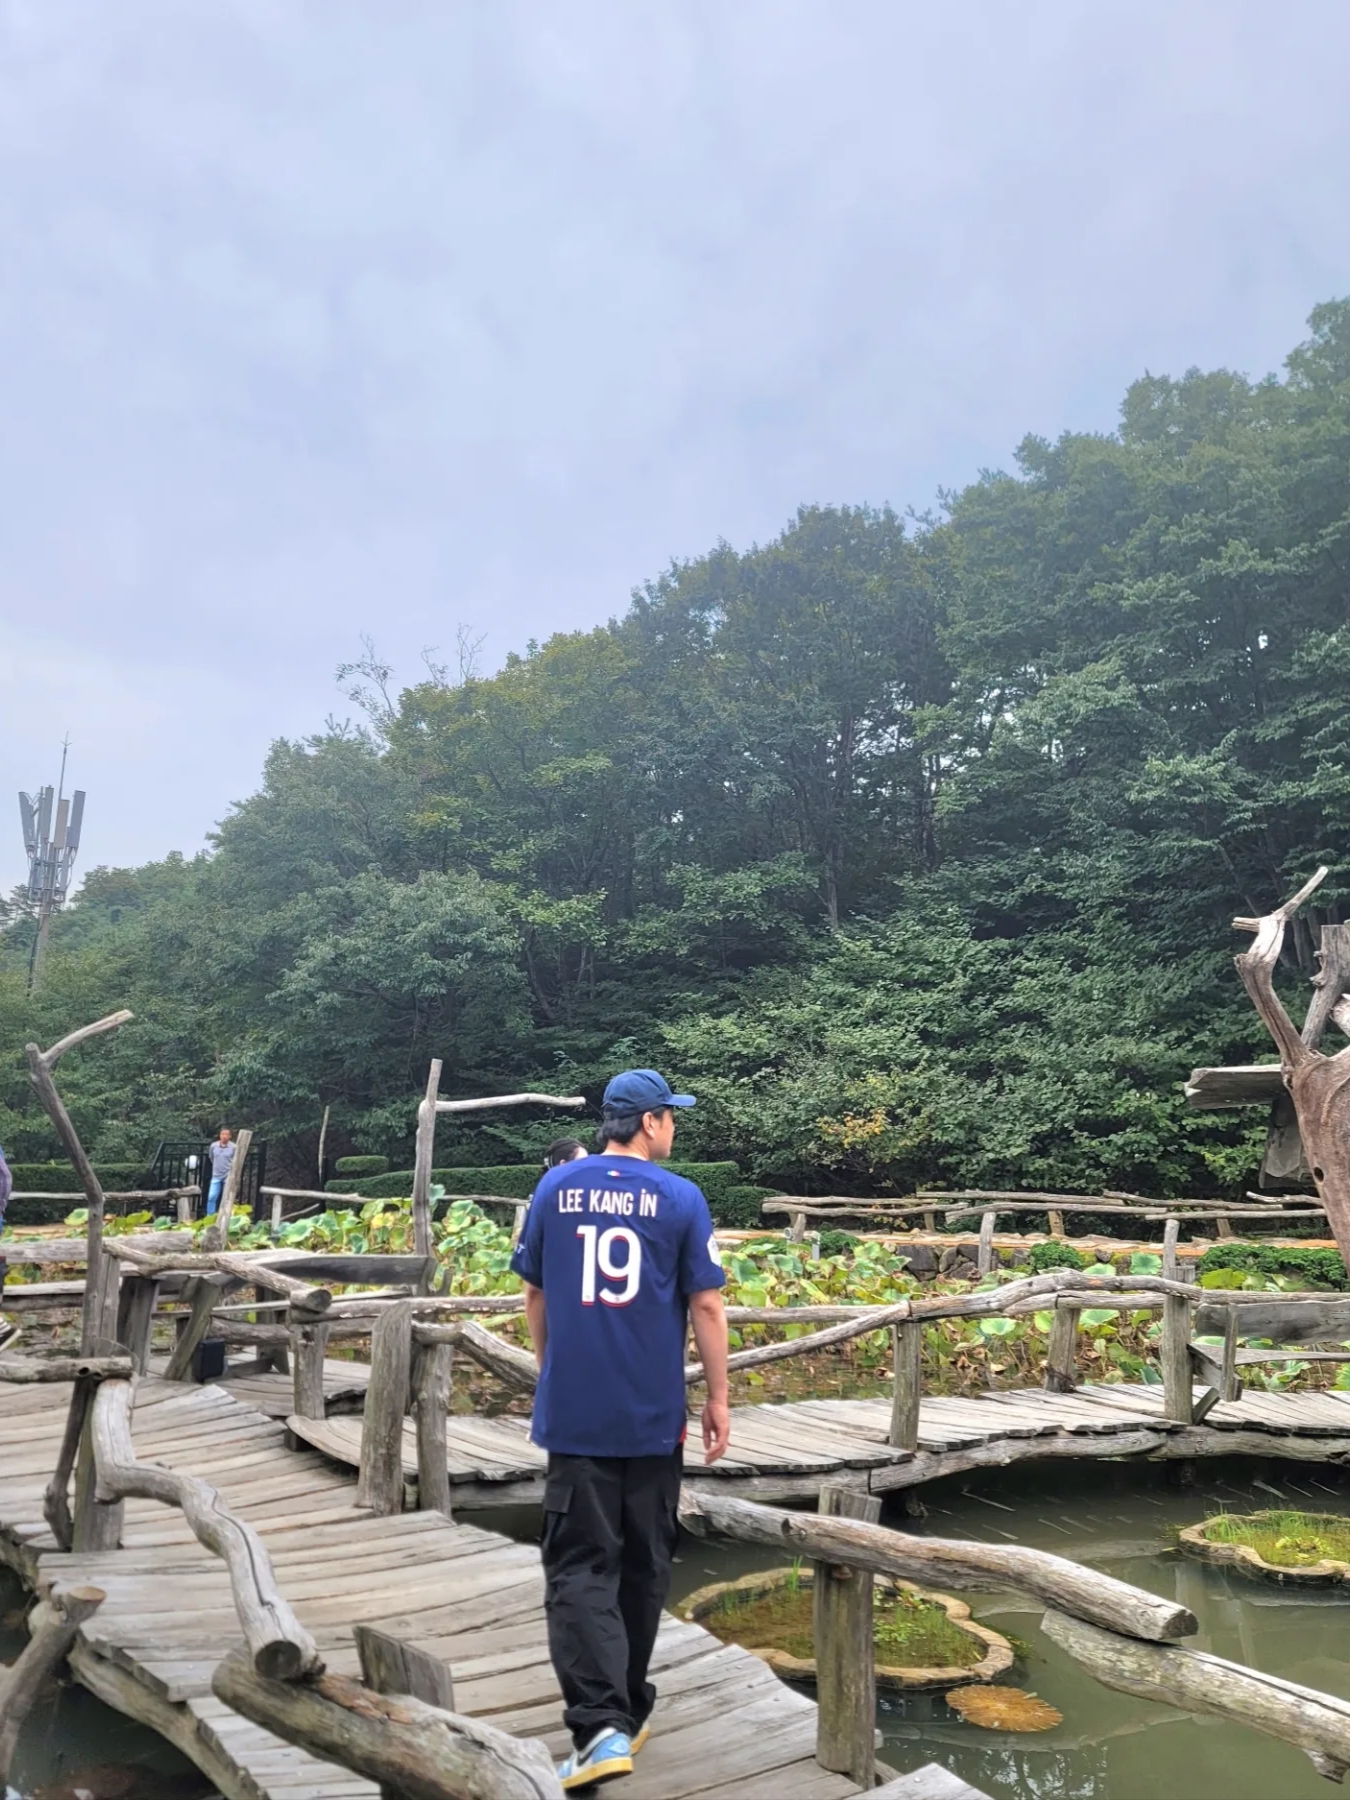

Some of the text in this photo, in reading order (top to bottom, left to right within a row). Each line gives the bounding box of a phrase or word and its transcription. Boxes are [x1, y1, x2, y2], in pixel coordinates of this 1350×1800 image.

[558, 1188, 584, 1213] LEE
[589, 1189, 634, 1216] KANG
[576, 1225, 642, 1307] 19
